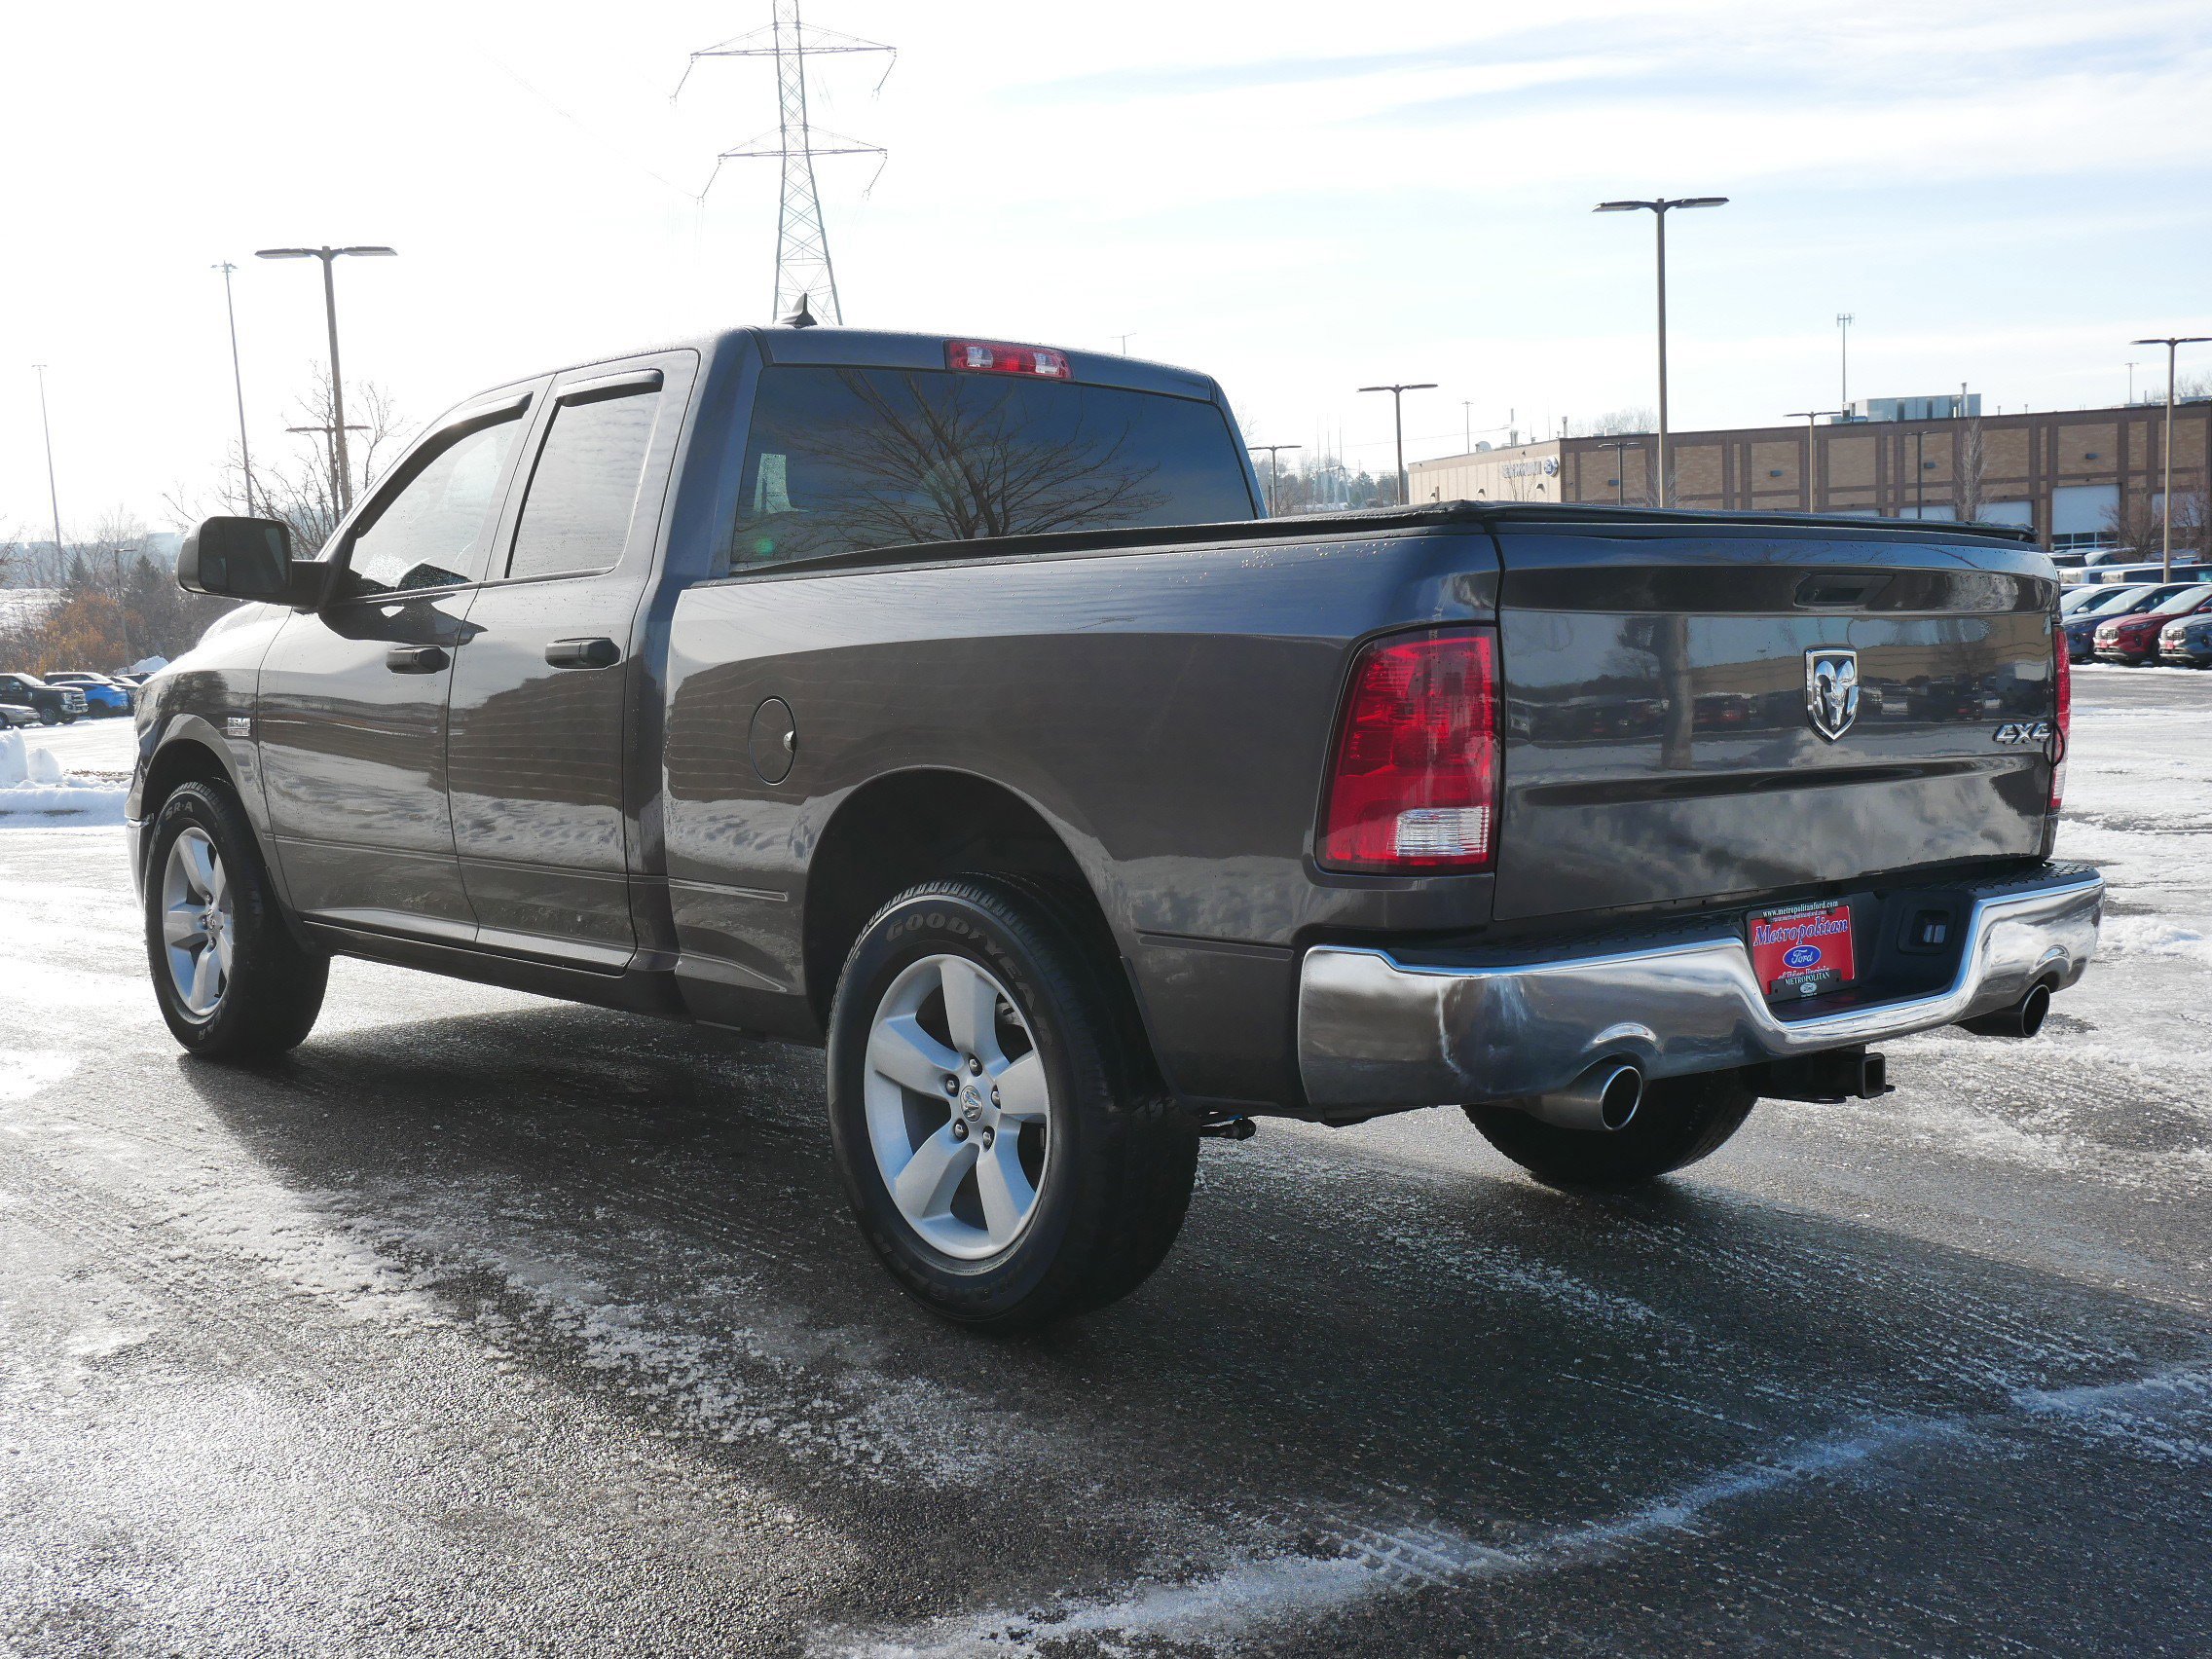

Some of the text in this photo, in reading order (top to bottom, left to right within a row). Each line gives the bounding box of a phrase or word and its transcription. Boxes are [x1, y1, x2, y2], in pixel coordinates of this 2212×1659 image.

[1763, 901, 1838, 917] www.metropolitanford.com
[1752, 916, 1848, 946] Metropolitan
[1791, 949, 1813, 964] Ford
[886, 912, 1053, 1048] GOODYEAR
[1785, 972, 1829, 985] METROPOLITAN
